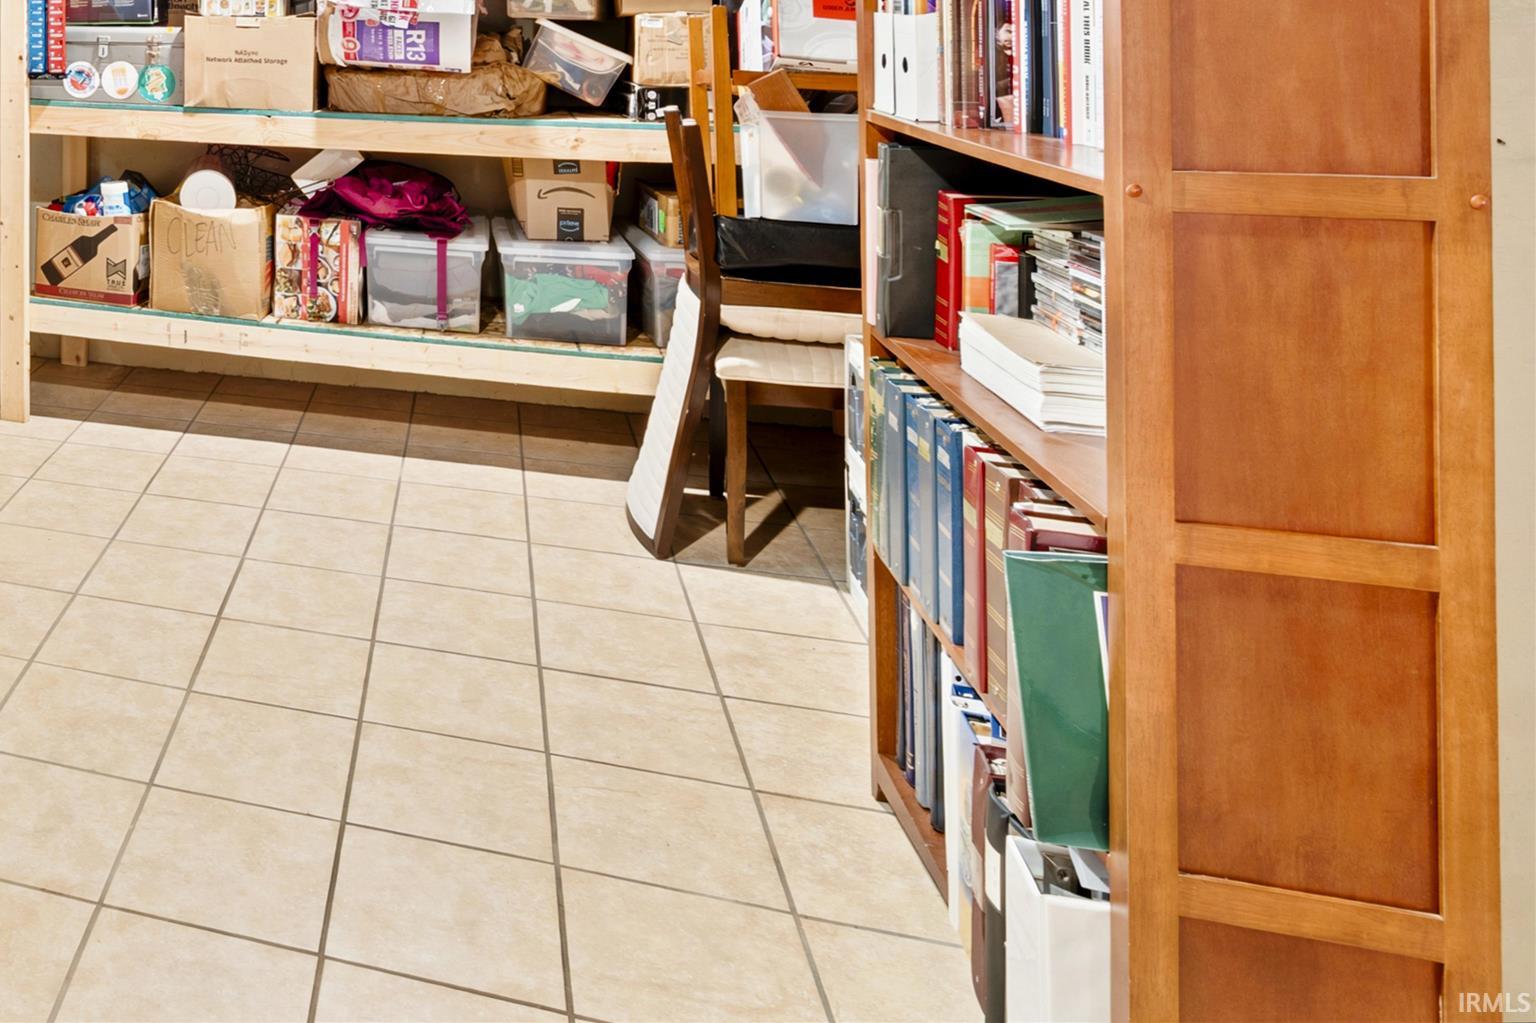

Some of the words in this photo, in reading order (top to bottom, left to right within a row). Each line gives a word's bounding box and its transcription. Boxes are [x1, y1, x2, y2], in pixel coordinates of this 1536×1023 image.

[263, 58, 288, 66] Storage
[406, 29, 427, 62] R13
[166, 216, 237, 257] CLEAN
